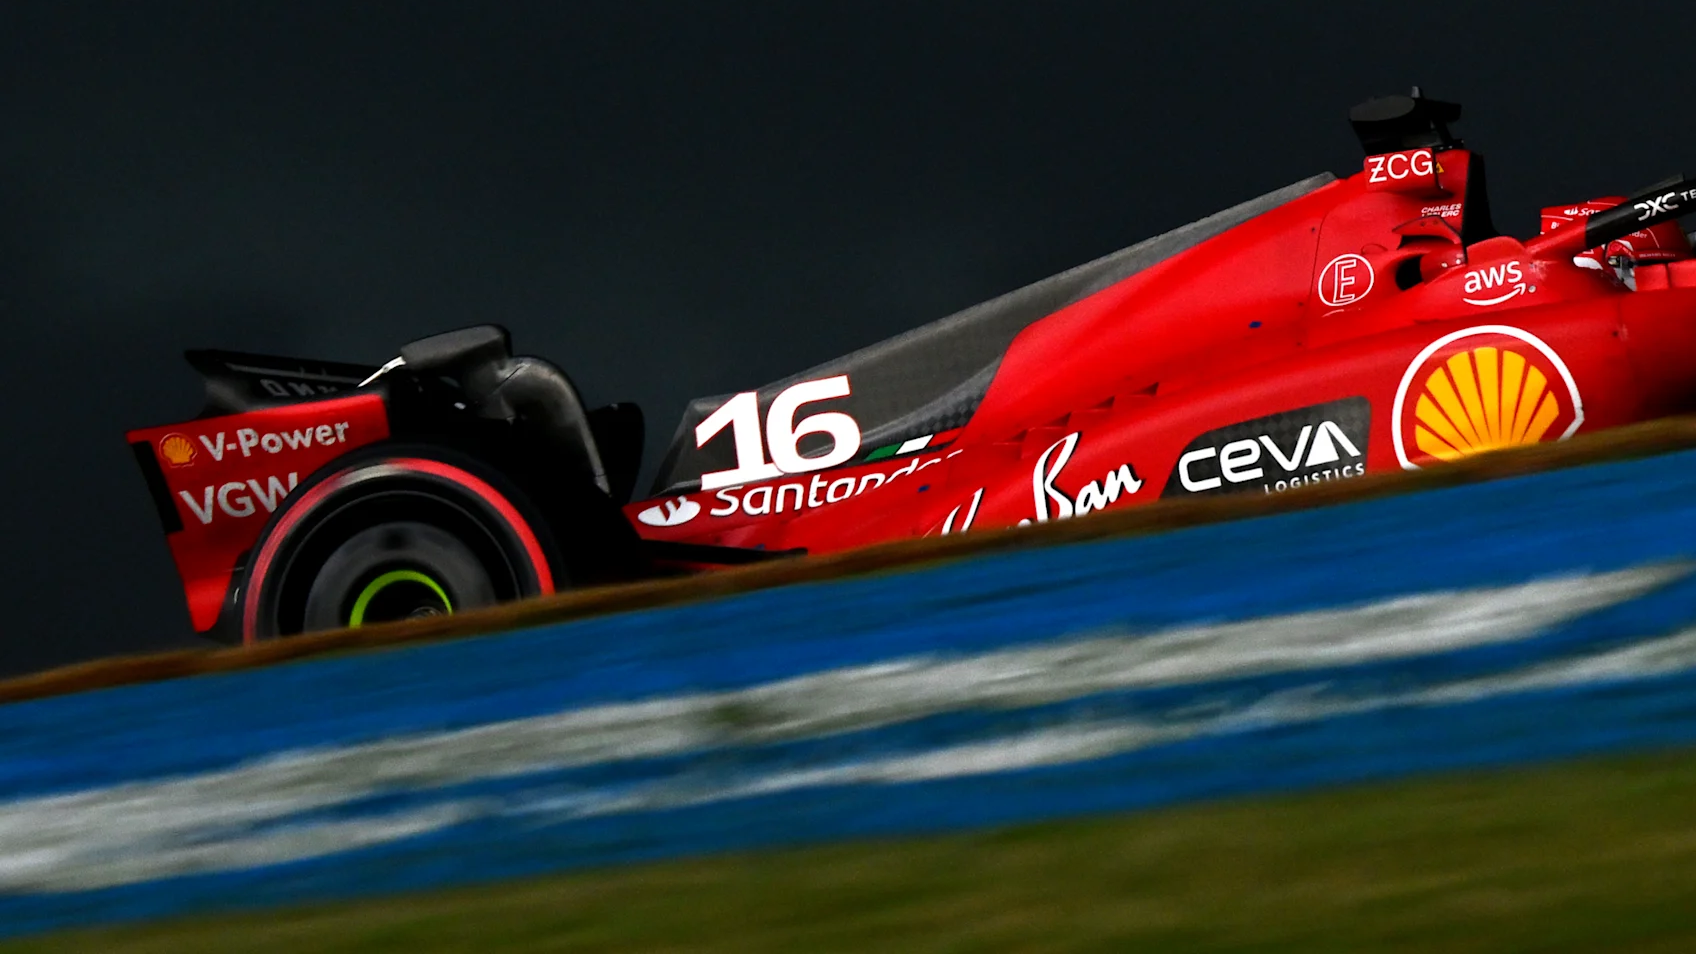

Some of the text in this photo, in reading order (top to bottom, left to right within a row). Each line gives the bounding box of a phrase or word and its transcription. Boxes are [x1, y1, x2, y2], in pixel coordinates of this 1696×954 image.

[1421, 203, 1462, 215] CHARLES
[1634, 192, 1679, 221] DXC
[1464, 261, 1523, 294] aws
[199, 422, 349, 462] V-Power
[695, 375, 861, 490] 16
[1264, 462, 1365, 495] LOGISTICS
